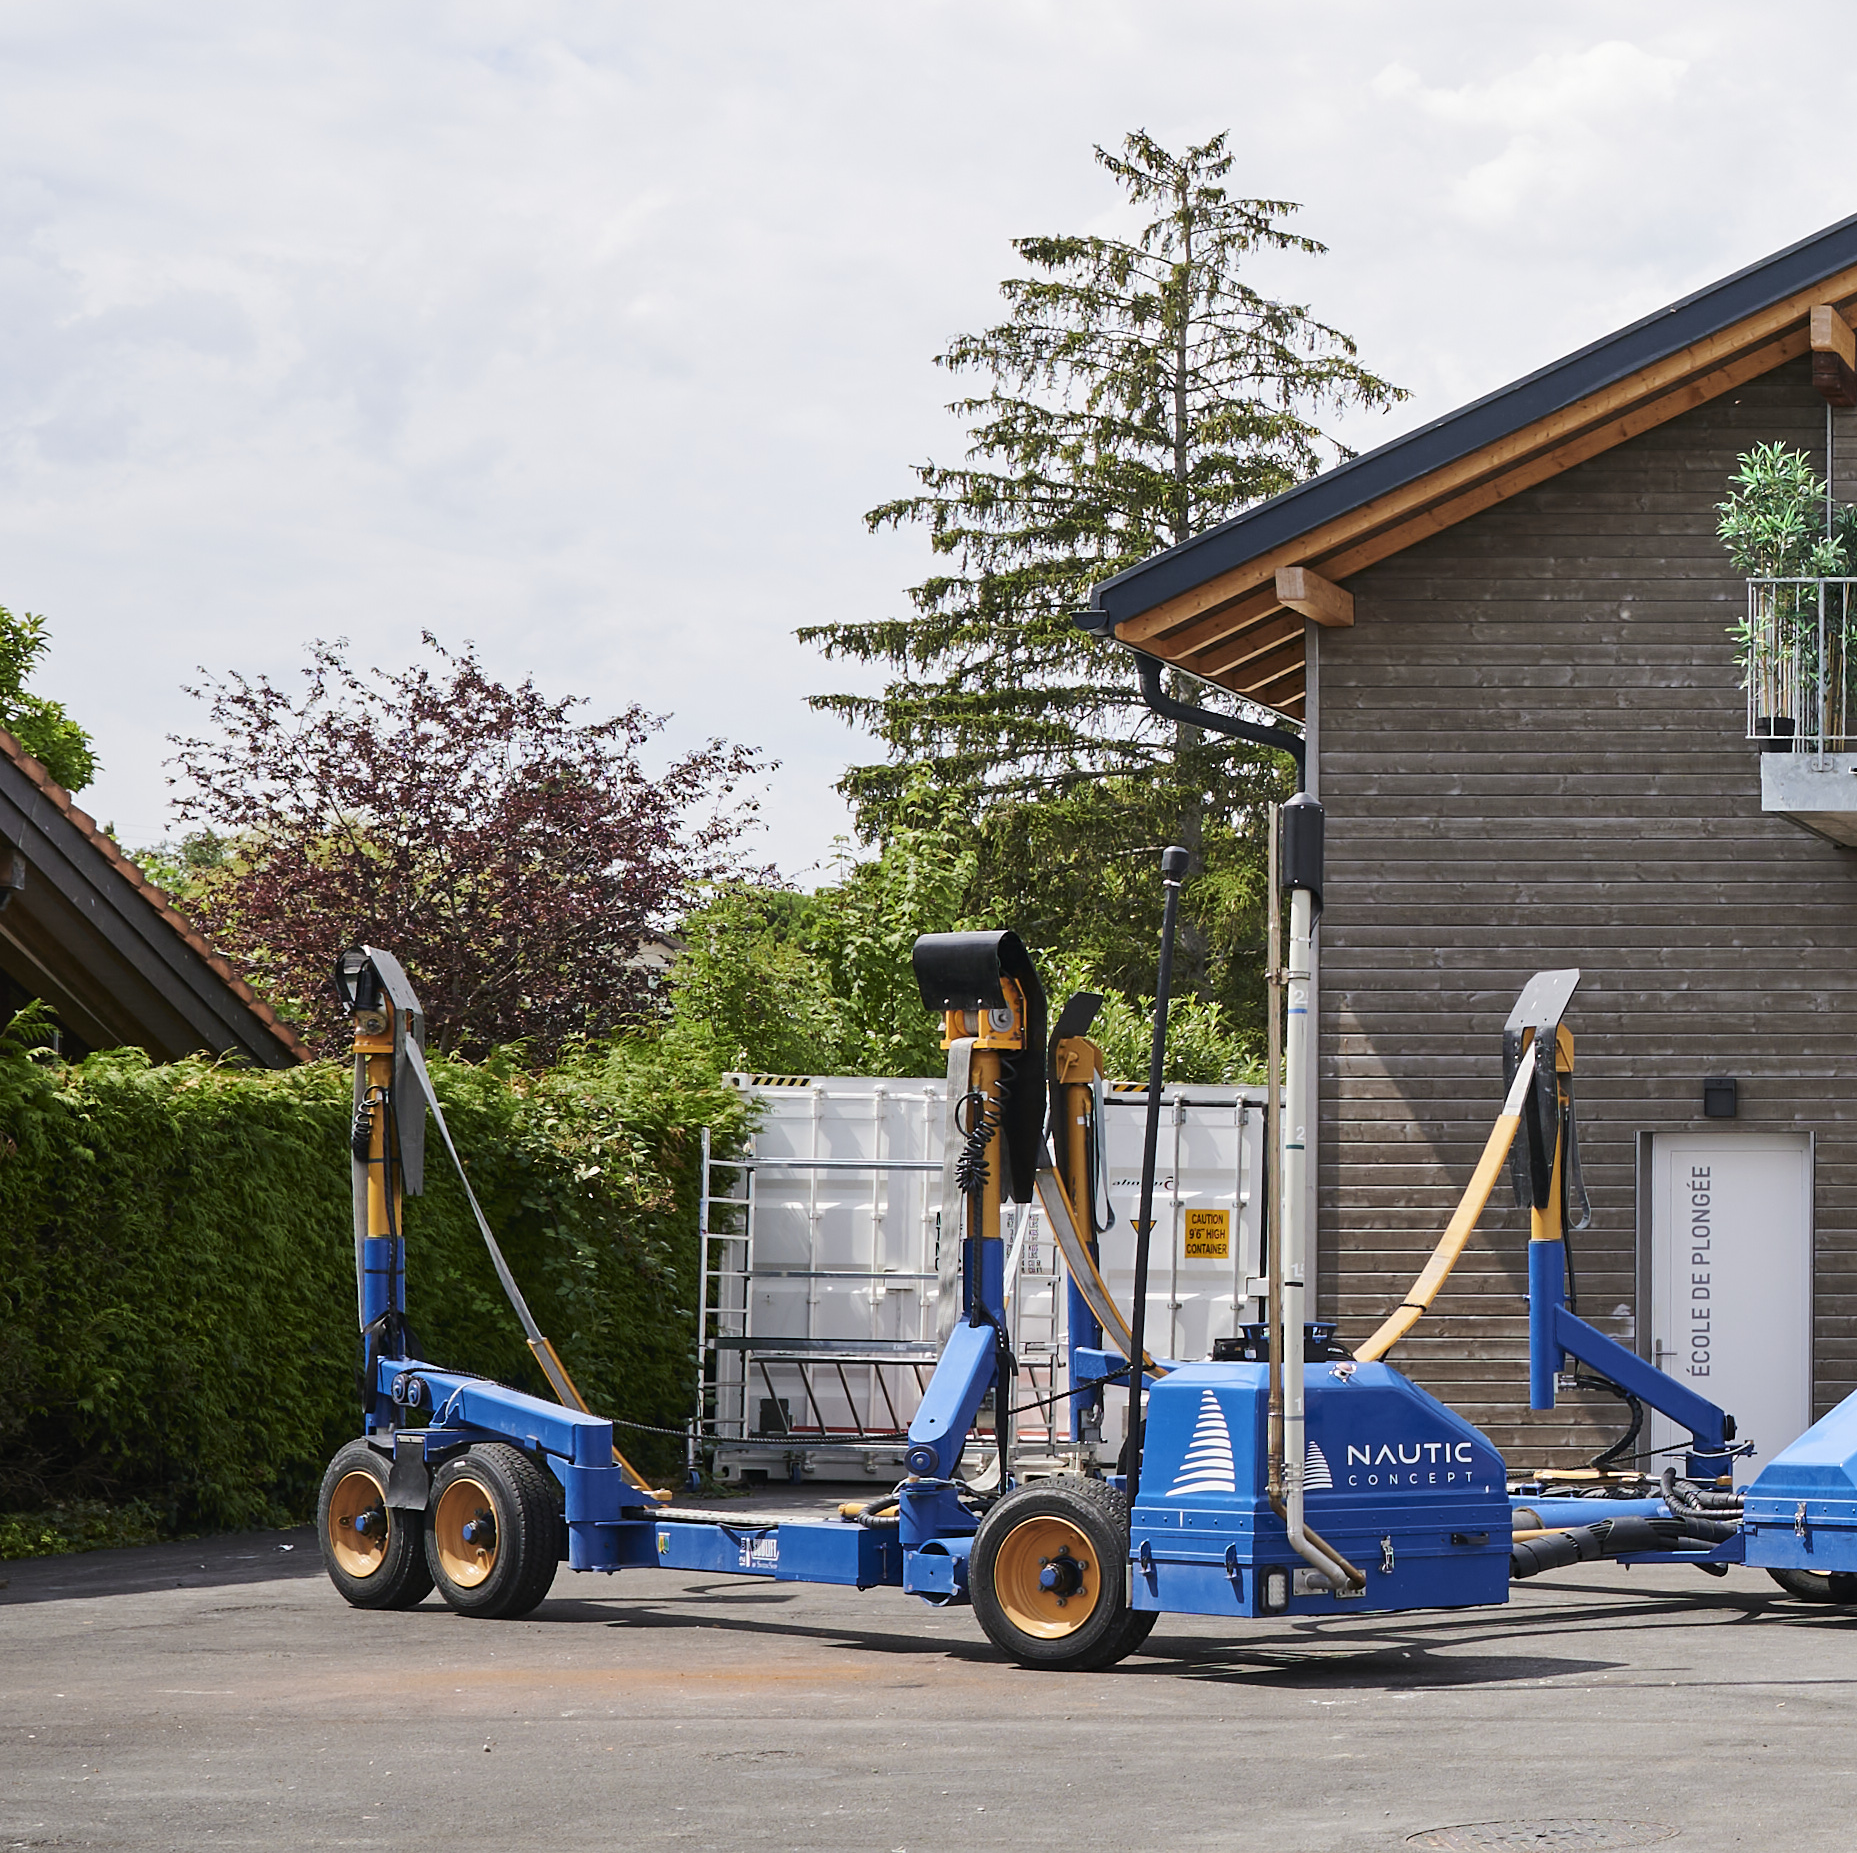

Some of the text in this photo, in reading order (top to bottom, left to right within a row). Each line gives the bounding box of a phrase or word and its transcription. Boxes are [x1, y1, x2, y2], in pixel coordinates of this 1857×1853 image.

[1191, 1213, 1223, 1224] CAUTION
[1206, 1229, 1225, 1239] HIGH
[1186, 1243, 1227, 1254] CONTAINER
[1686, 1166, 1711, 1377] ÉCOLE DE PLONGÉE
[1347, 1442, 1473, 1466] NAUTIC
[1348, 1471, 1473, 1487] CONCEPT
